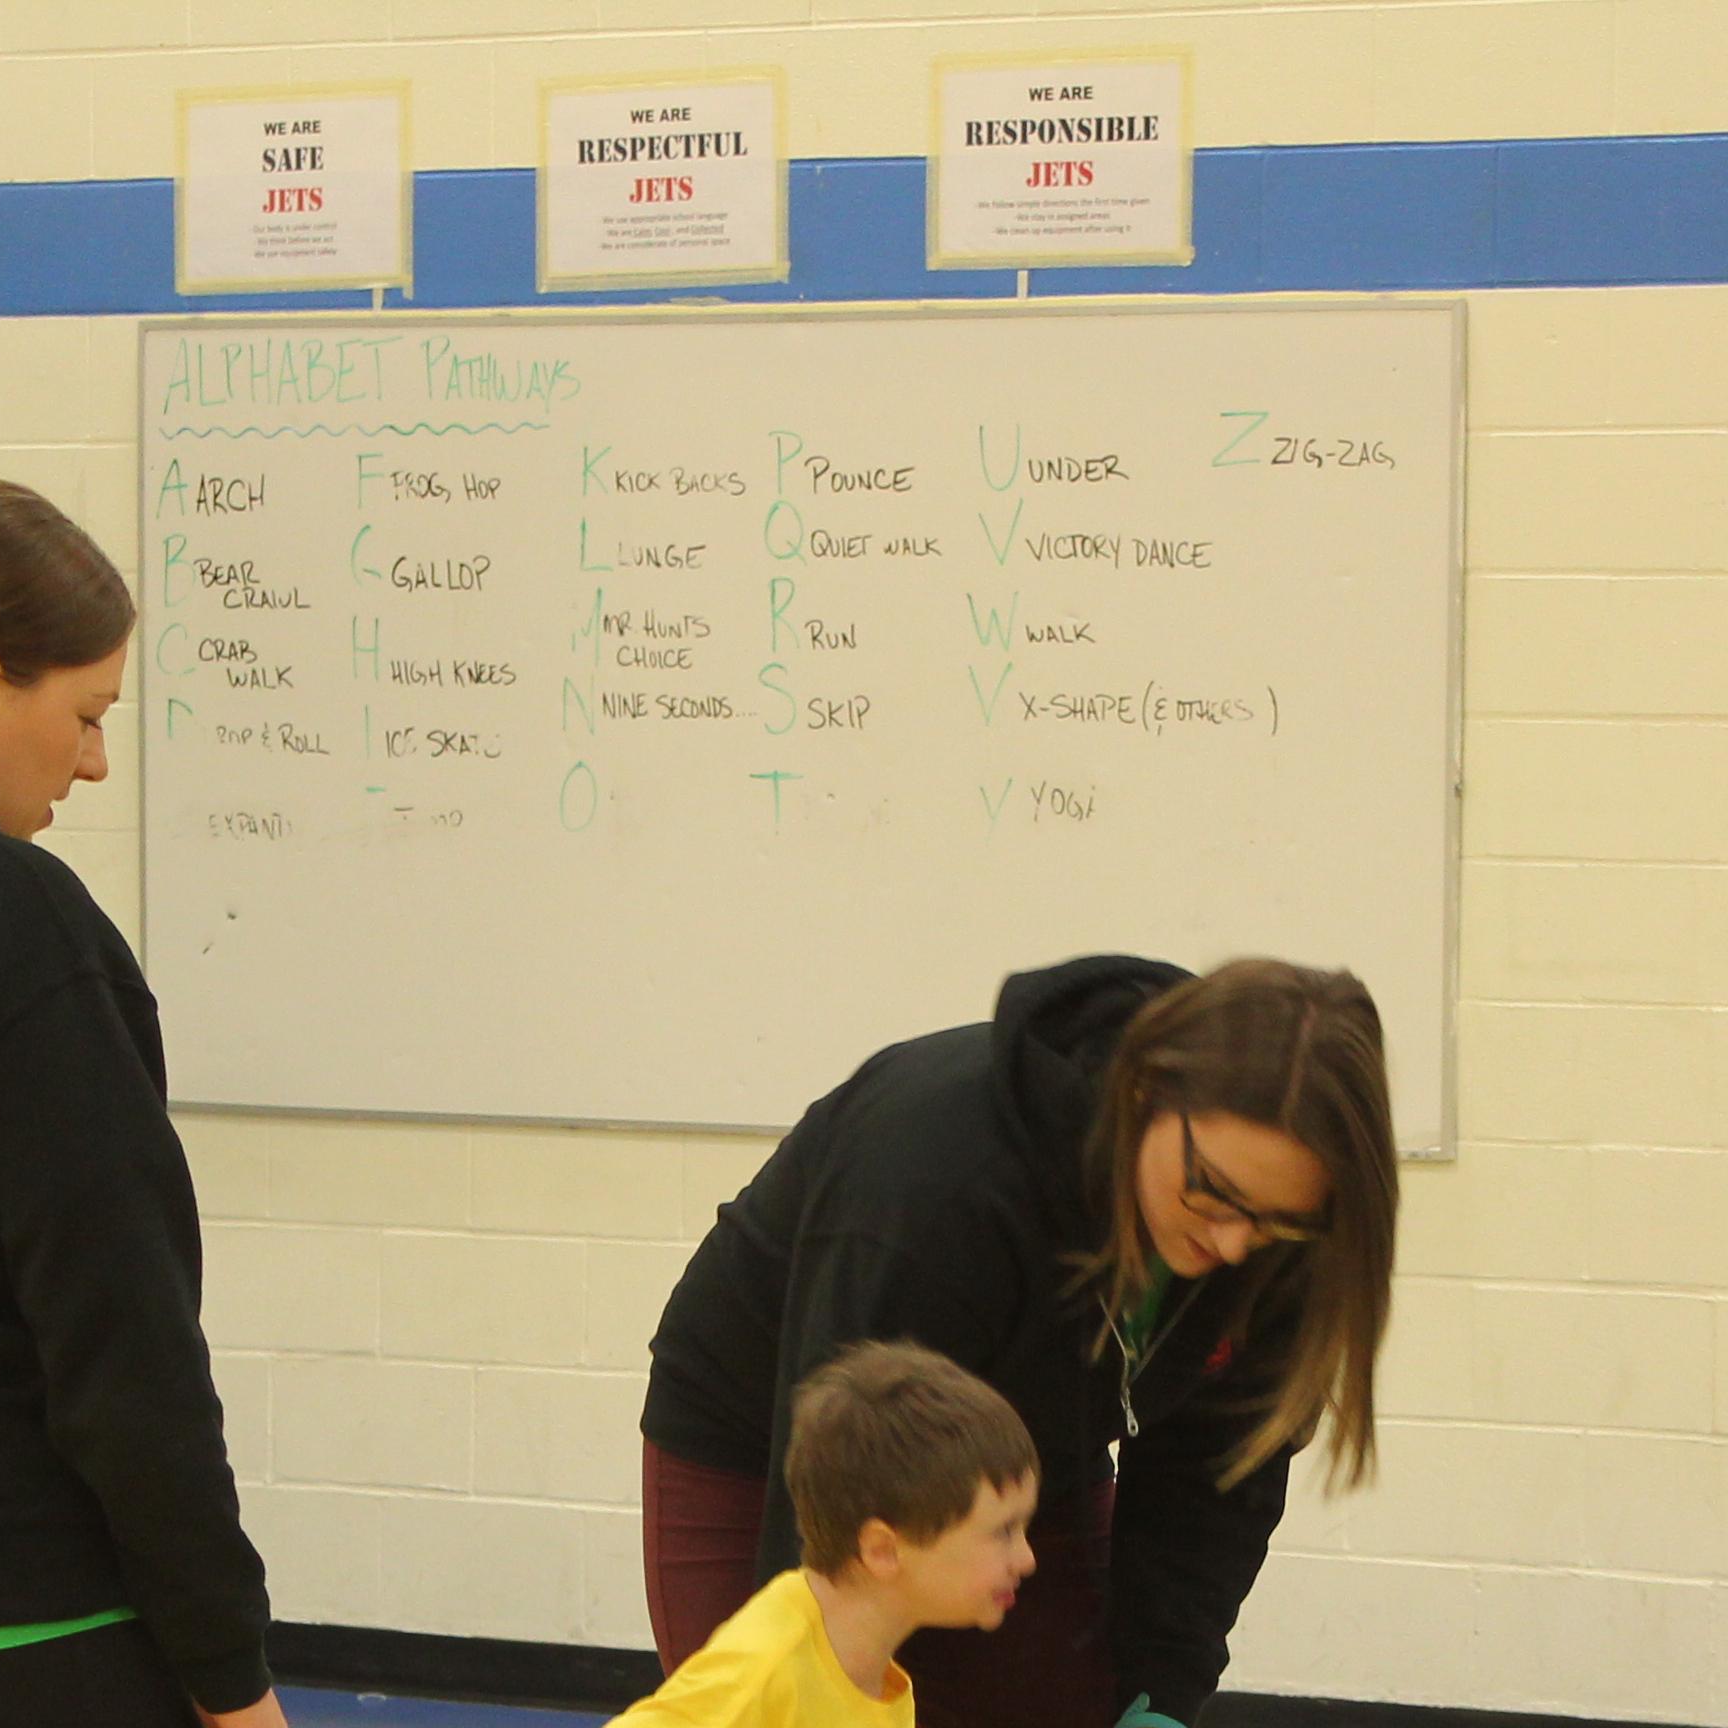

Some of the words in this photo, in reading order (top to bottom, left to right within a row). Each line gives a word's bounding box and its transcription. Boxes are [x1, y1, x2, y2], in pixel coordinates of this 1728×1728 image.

[630, 109, 657, 124] WE
[660, 107, 691, 122] ARE
[1029, 87, 1054, 101] WE
[1060, 86, 1093, 100] ARE
[263, 122, 287, 135] WE
[292, 120, 321, 133] ARE
[577, 131, 749, 165] RESPECTFUL
[965, 115, 1159, 147] RESPONSIBLE
[262, 147, 324, 173] SAFE
[1025, 160, 1094, 188] JETS
[262, 187, 323, 214] JETS
[629, 176, 693, 204] JETS
[164, 337, 403, 414] ALPHABET
[422, 335, 581, 413] PATHWAYS
[767, 430, 803, 494] P
[804, 456, 916, 494] POUNCE
[979, 423, 1021, 491] U
[1028, 455, 1130, 484] UNDER
[1212, 411, 1270, 468] Z
[1271, 437, 1396, 469] ZIG-ZAG
[156, 459, 188, 518] A
[196, 474, 266, 517] ARCH
[357, 453, 384, 509] F
[465, 473, 501, 501] HOP
[582, 446, 612, 496] K
[615, 469, 660, 492] KICK
[670, 467, 747, 496] BACKS
[580, 517, 614, 571] L
[618, 542, 706, 569] LUNGE
[764, 500, 808, 566] Q
[810, 529, 873, 558] QUIET
[883, 538, 943, 557] WALK
[979, 498, 1023, 566] V
[1026, 534, 1122, 569] VICTORY
[1133, 538, 1213, 569] DANCE
[194, 558, 260, 587] BEAR
[391, 555, 491, 592] GALLOP
[224, 588, 311, 610] CRAWL
[770, 577, 800, 653] R
[805, 620, 857, 650] RUN
[966, 591, 1019, 651] W
[1026, 623, 1096, 645] WALK
[157, 623, 195, 675] C
[198, 639, 258, 663] CRAB
[352, 615, 381, 681] H
[391, 660, 444, 687] HIGH
[454, 659, 516, 686] KNEES
[617, 646, 693, 669] CHOICE
[227, 667, 293, 690] WALK
[758, 663, 797, 734] S
[807, 695, 871, 730] SKIP
[562, 675, 595, 736] N
[602, 692, 649, 719] NINE
[1019, 692, 1136, 725] X-SHAPE
[278, 723, 330, 755] ROLL
[749, 769, 804, 824] T
